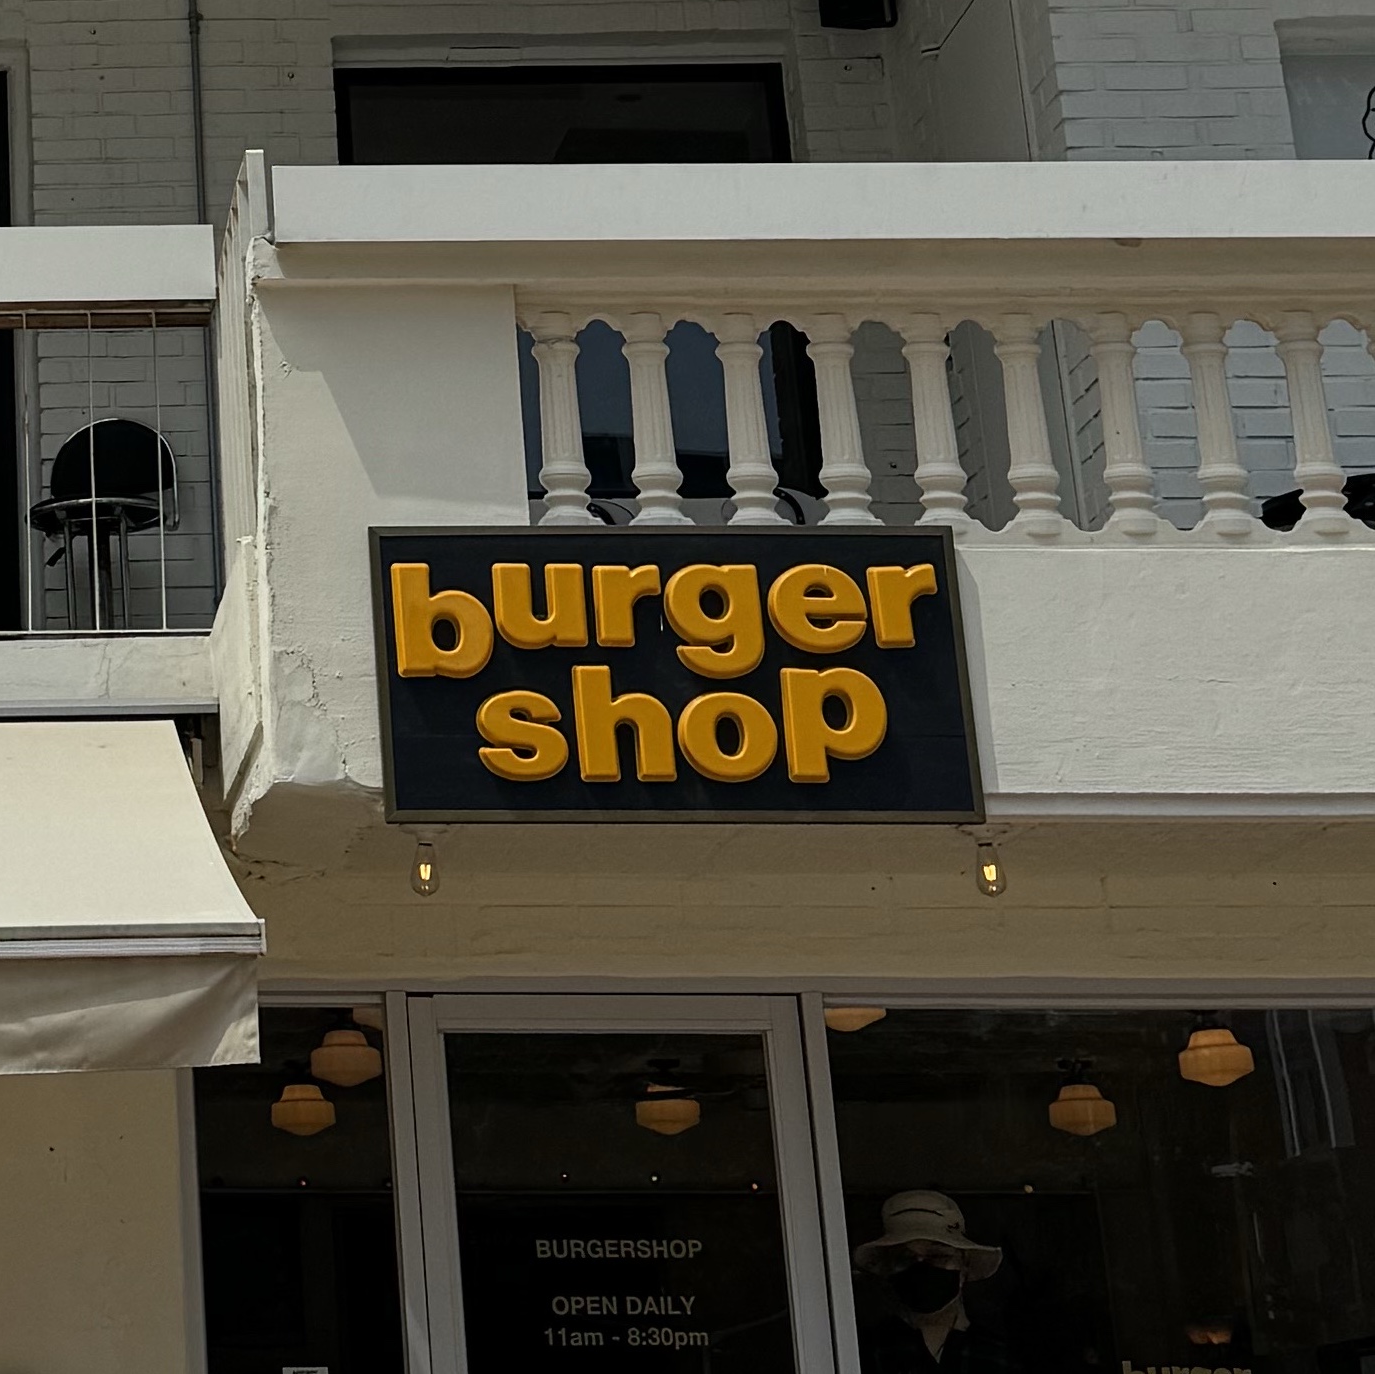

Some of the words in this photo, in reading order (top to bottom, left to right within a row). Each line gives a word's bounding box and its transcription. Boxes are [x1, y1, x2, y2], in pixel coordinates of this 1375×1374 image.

[391, 563, 938, 679] burger
[476, 665, 887, 783] shop
[535, 1239, 703, 1259] BURGERSHOP
[551, 1296, 618, 1316] OPEN
[626, 1296, 696, 1316] DAILY
[544, 1327, 605, 1346] 11am
[627, 1327, 710, 1350] 8:30pm
